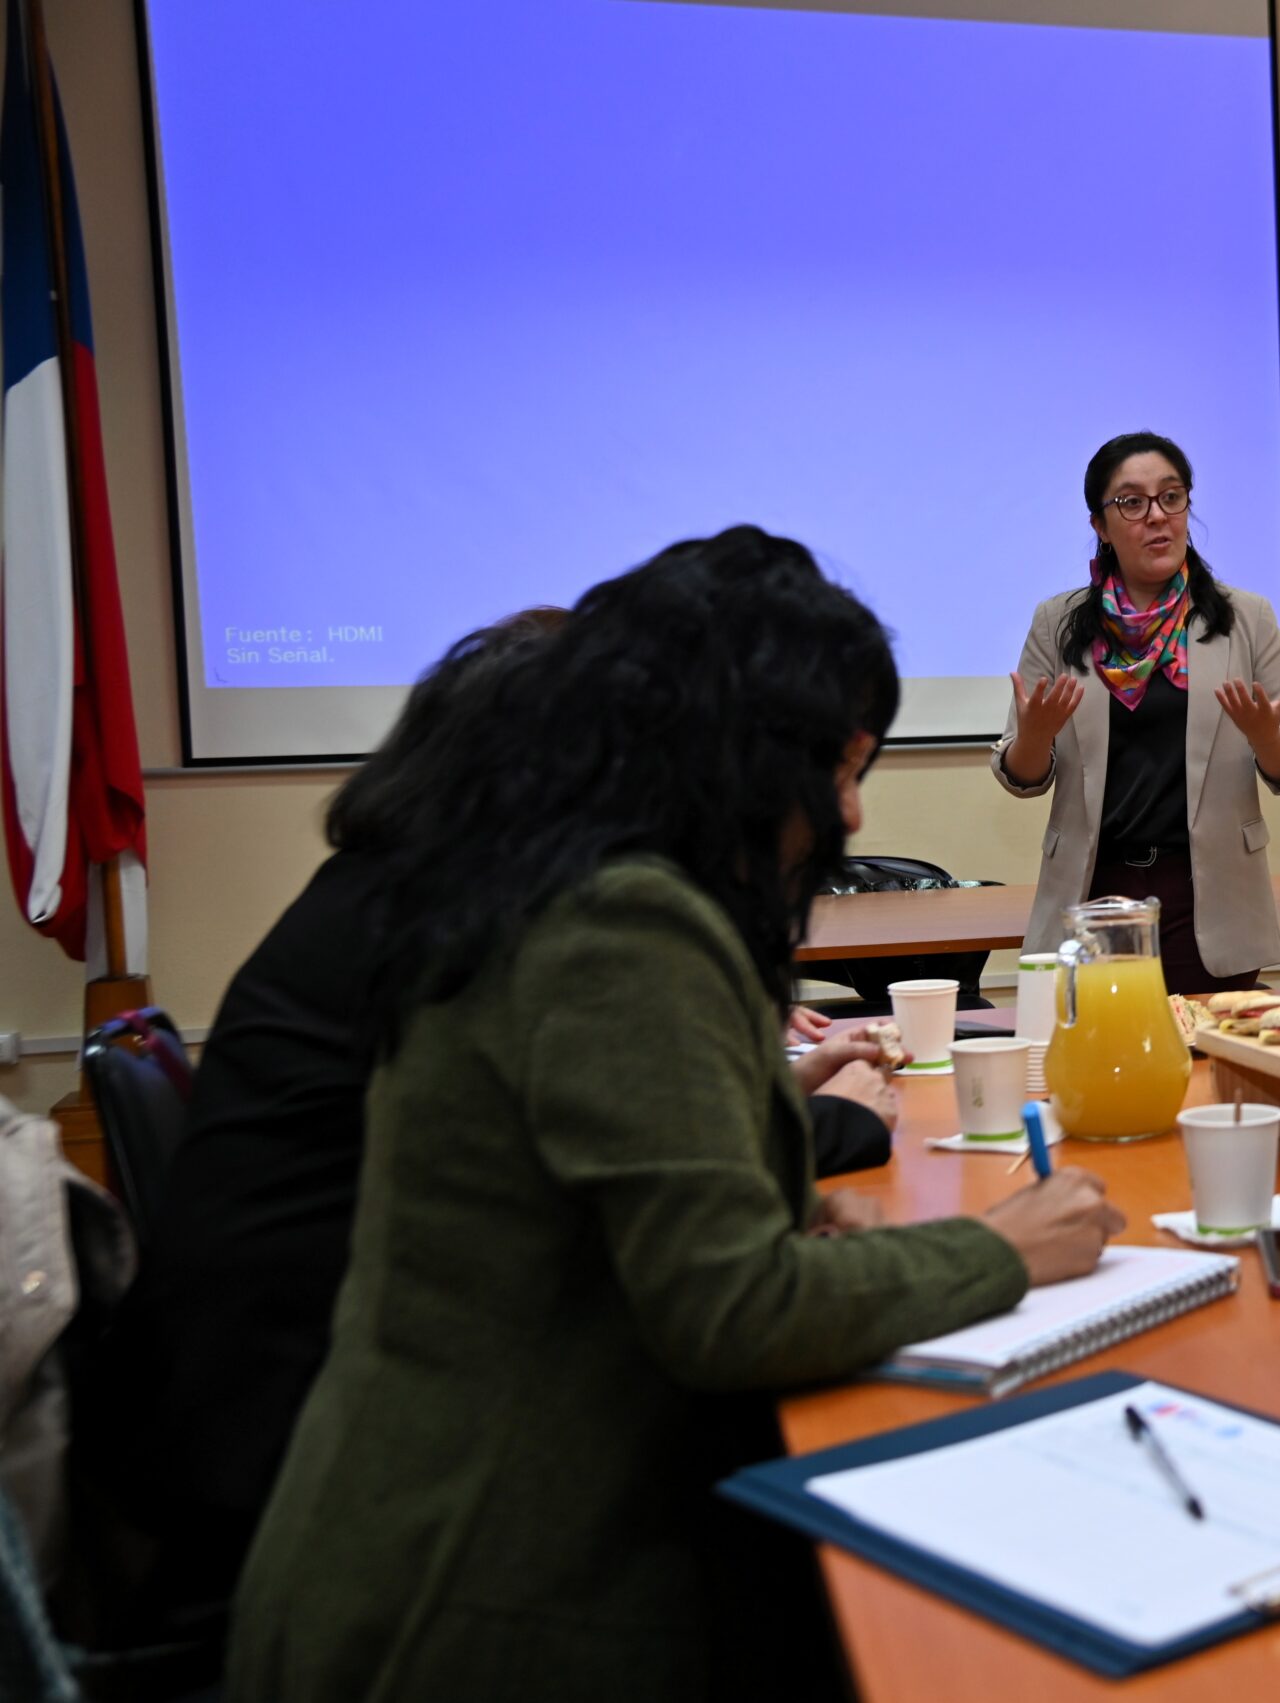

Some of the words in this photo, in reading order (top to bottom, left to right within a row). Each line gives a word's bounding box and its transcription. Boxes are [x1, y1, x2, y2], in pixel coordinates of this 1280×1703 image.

[225, 626, 313, 643] Fuente:
[328, 626, 383, 642] HDMI
[227, 647, 260, 664] Sin
[269, 646, 335, 663] Señal.
